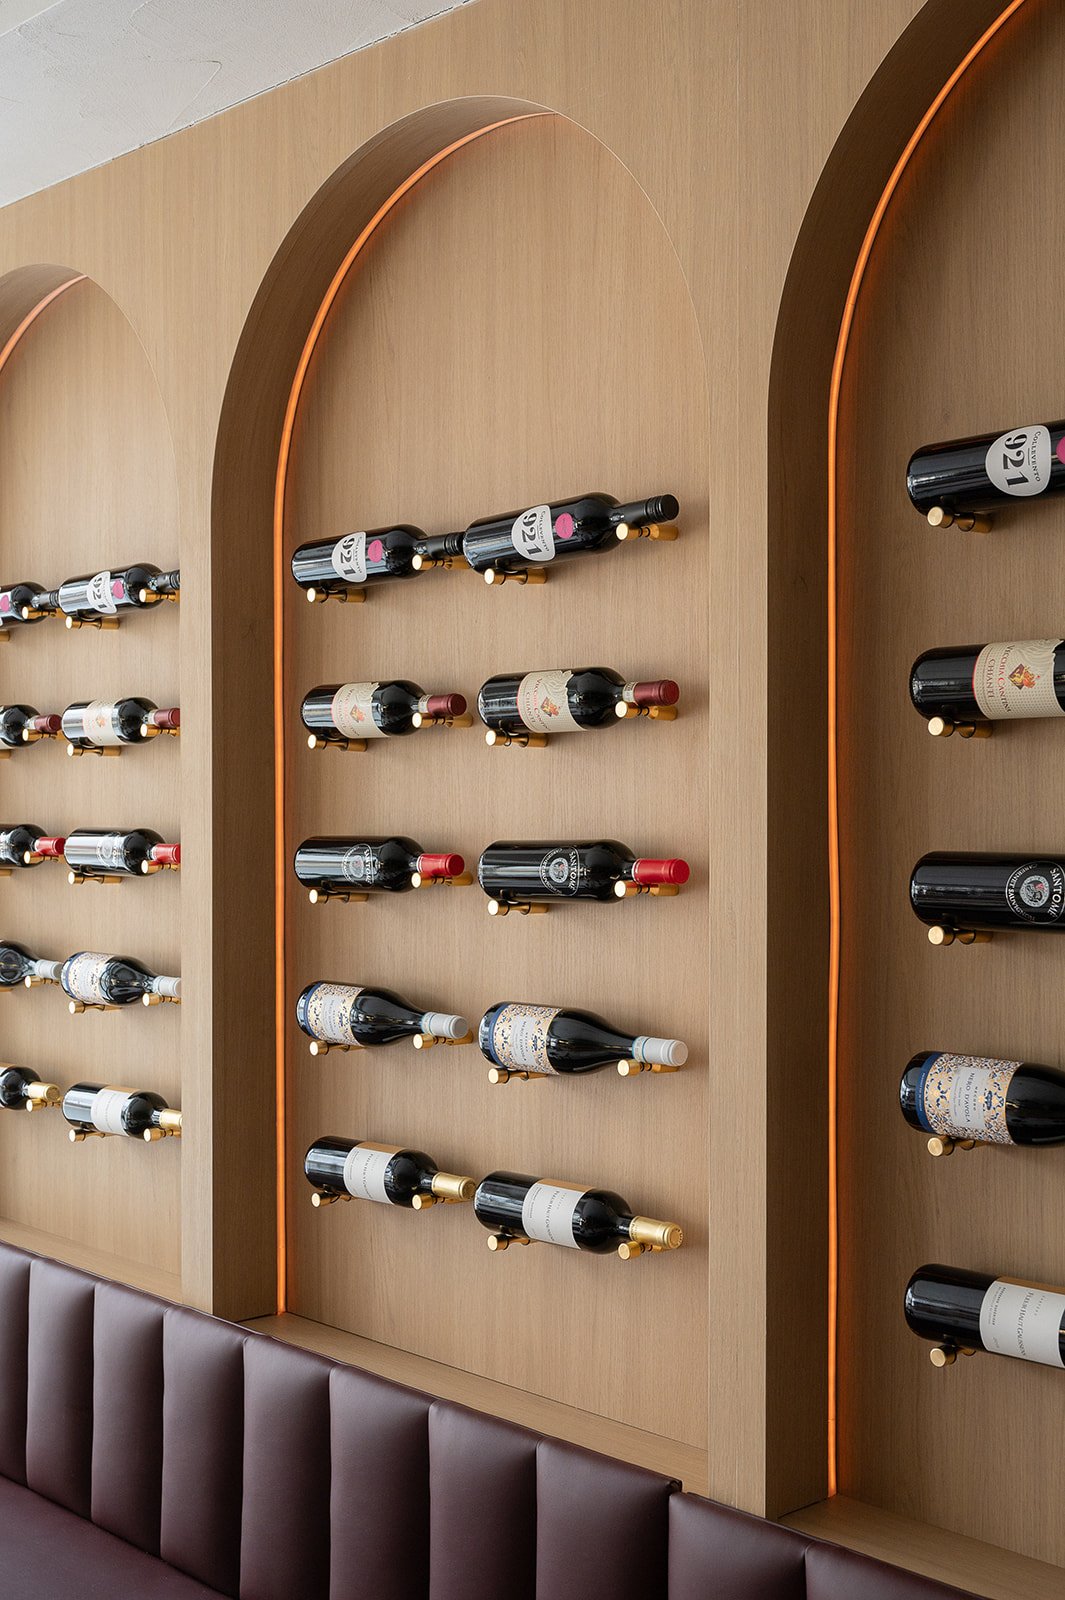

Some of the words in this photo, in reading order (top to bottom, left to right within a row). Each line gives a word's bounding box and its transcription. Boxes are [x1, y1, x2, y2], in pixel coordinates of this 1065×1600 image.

[1003, 434, 1029, 488] 921
[1031, 431, 1041, 481] COLLEVENTO
[522, 513, 542, 555] 921
[340, 538, 356, 575] 921
[93, 577, 107, 609] 921
[986, 659, 995, 698] CHIANTI
[966, 1073, 975, 1091] NERO
